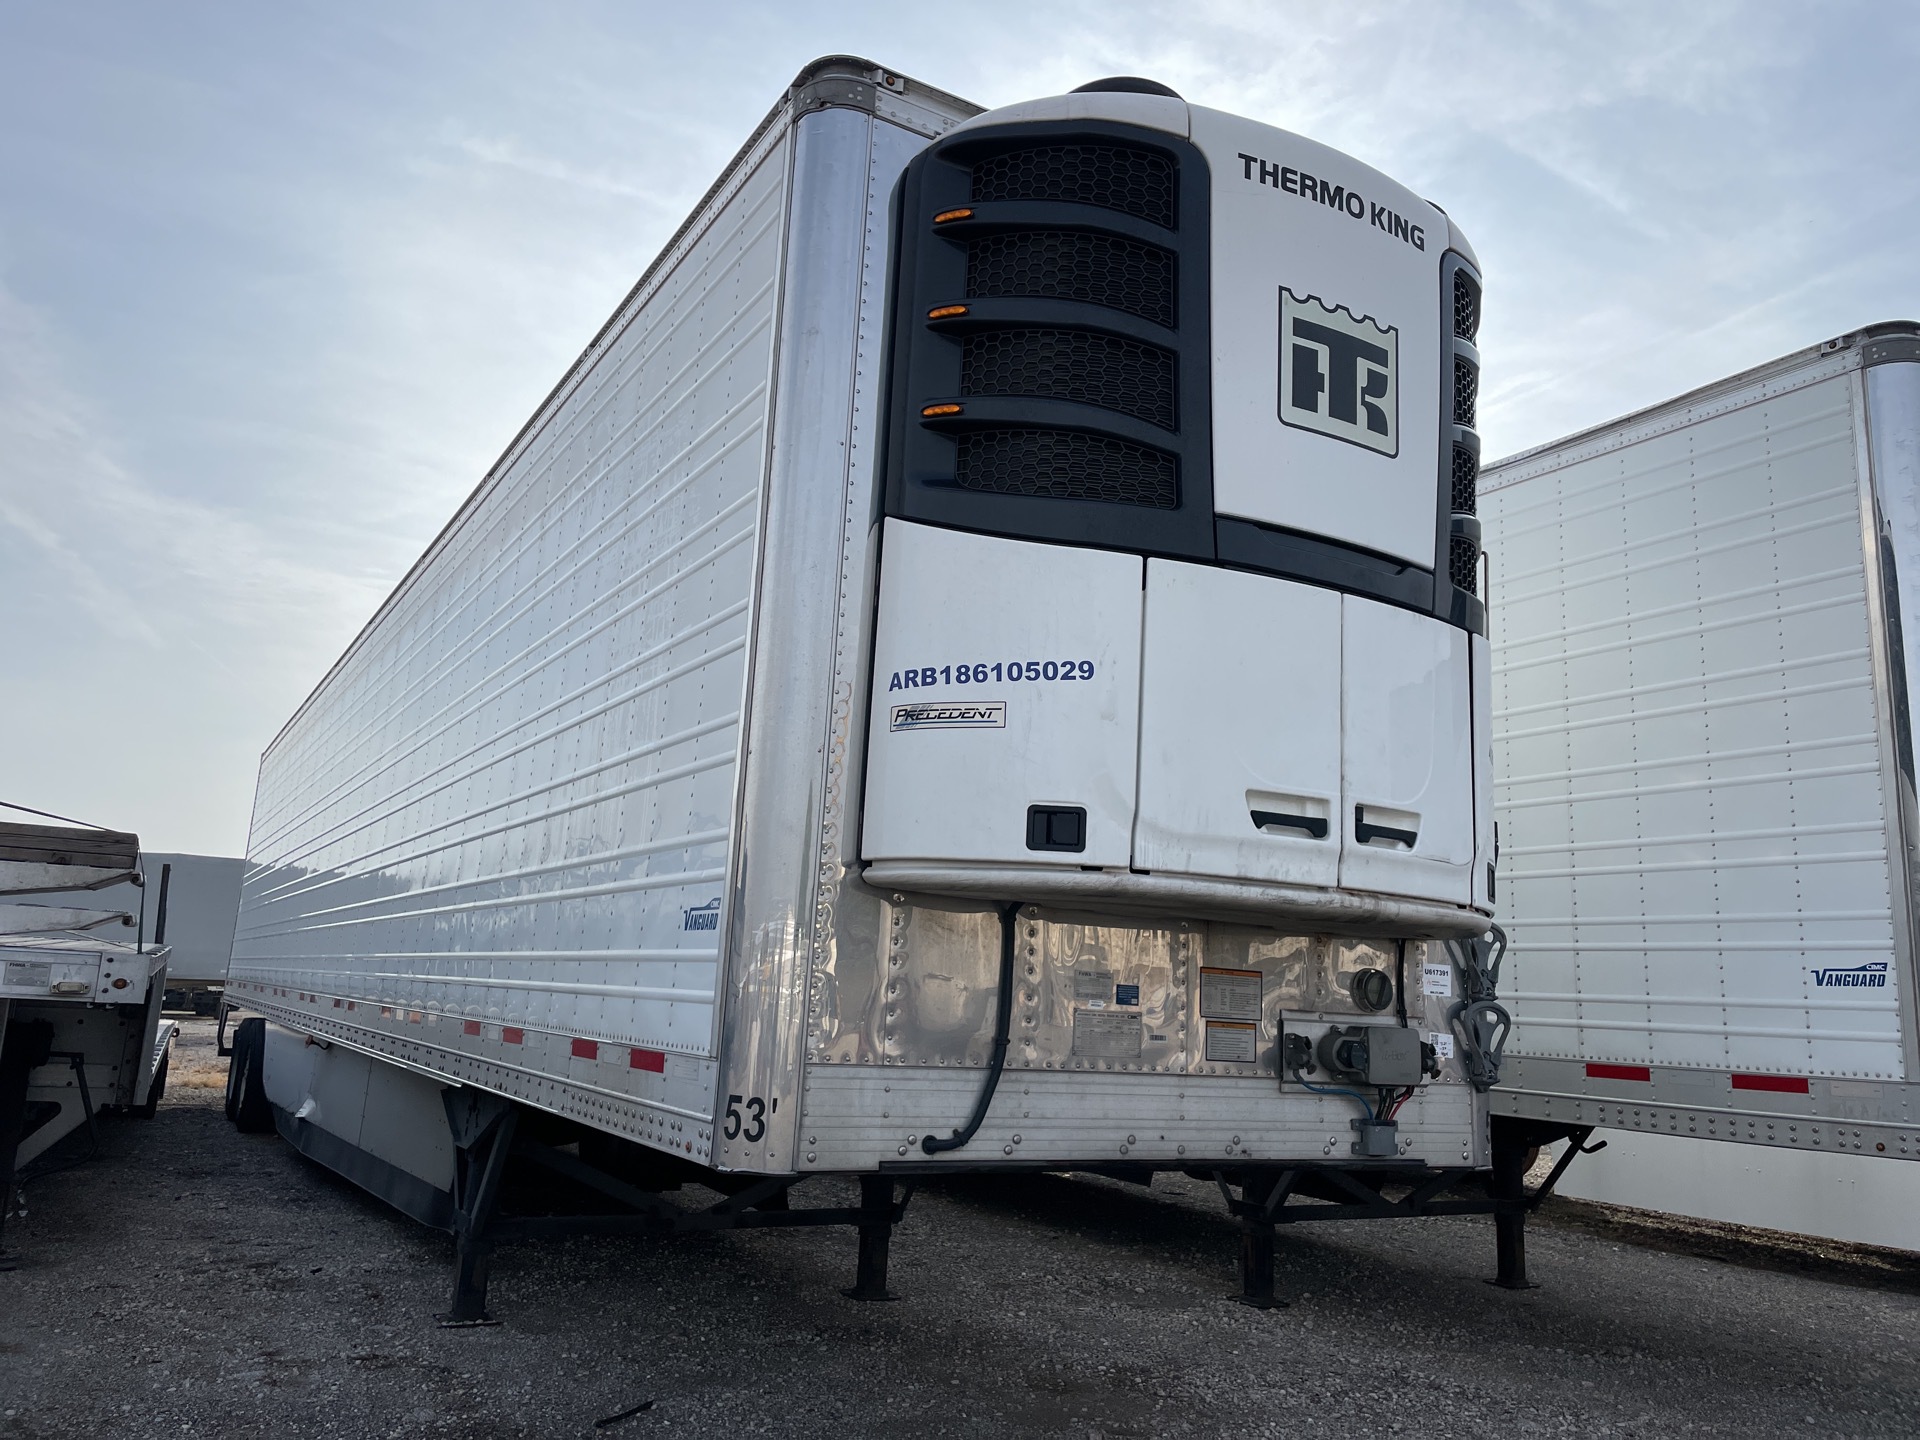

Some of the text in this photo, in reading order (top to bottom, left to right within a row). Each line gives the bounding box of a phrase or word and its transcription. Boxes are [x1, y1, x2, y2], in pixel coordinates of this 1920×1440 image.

[1238, 152, 1425, 252] THERMO KING
[888, 660, 1095, 692] ARB186105029
[893, 707, 1003, 723] PRECEDENT
[683, 908, 719, 931] VANGUARD
[1424, 968, 1449, 977] U617391
[1810, 969, 1886, 987] VANGUARD
[723, 1094, 778, 1143] 53'
